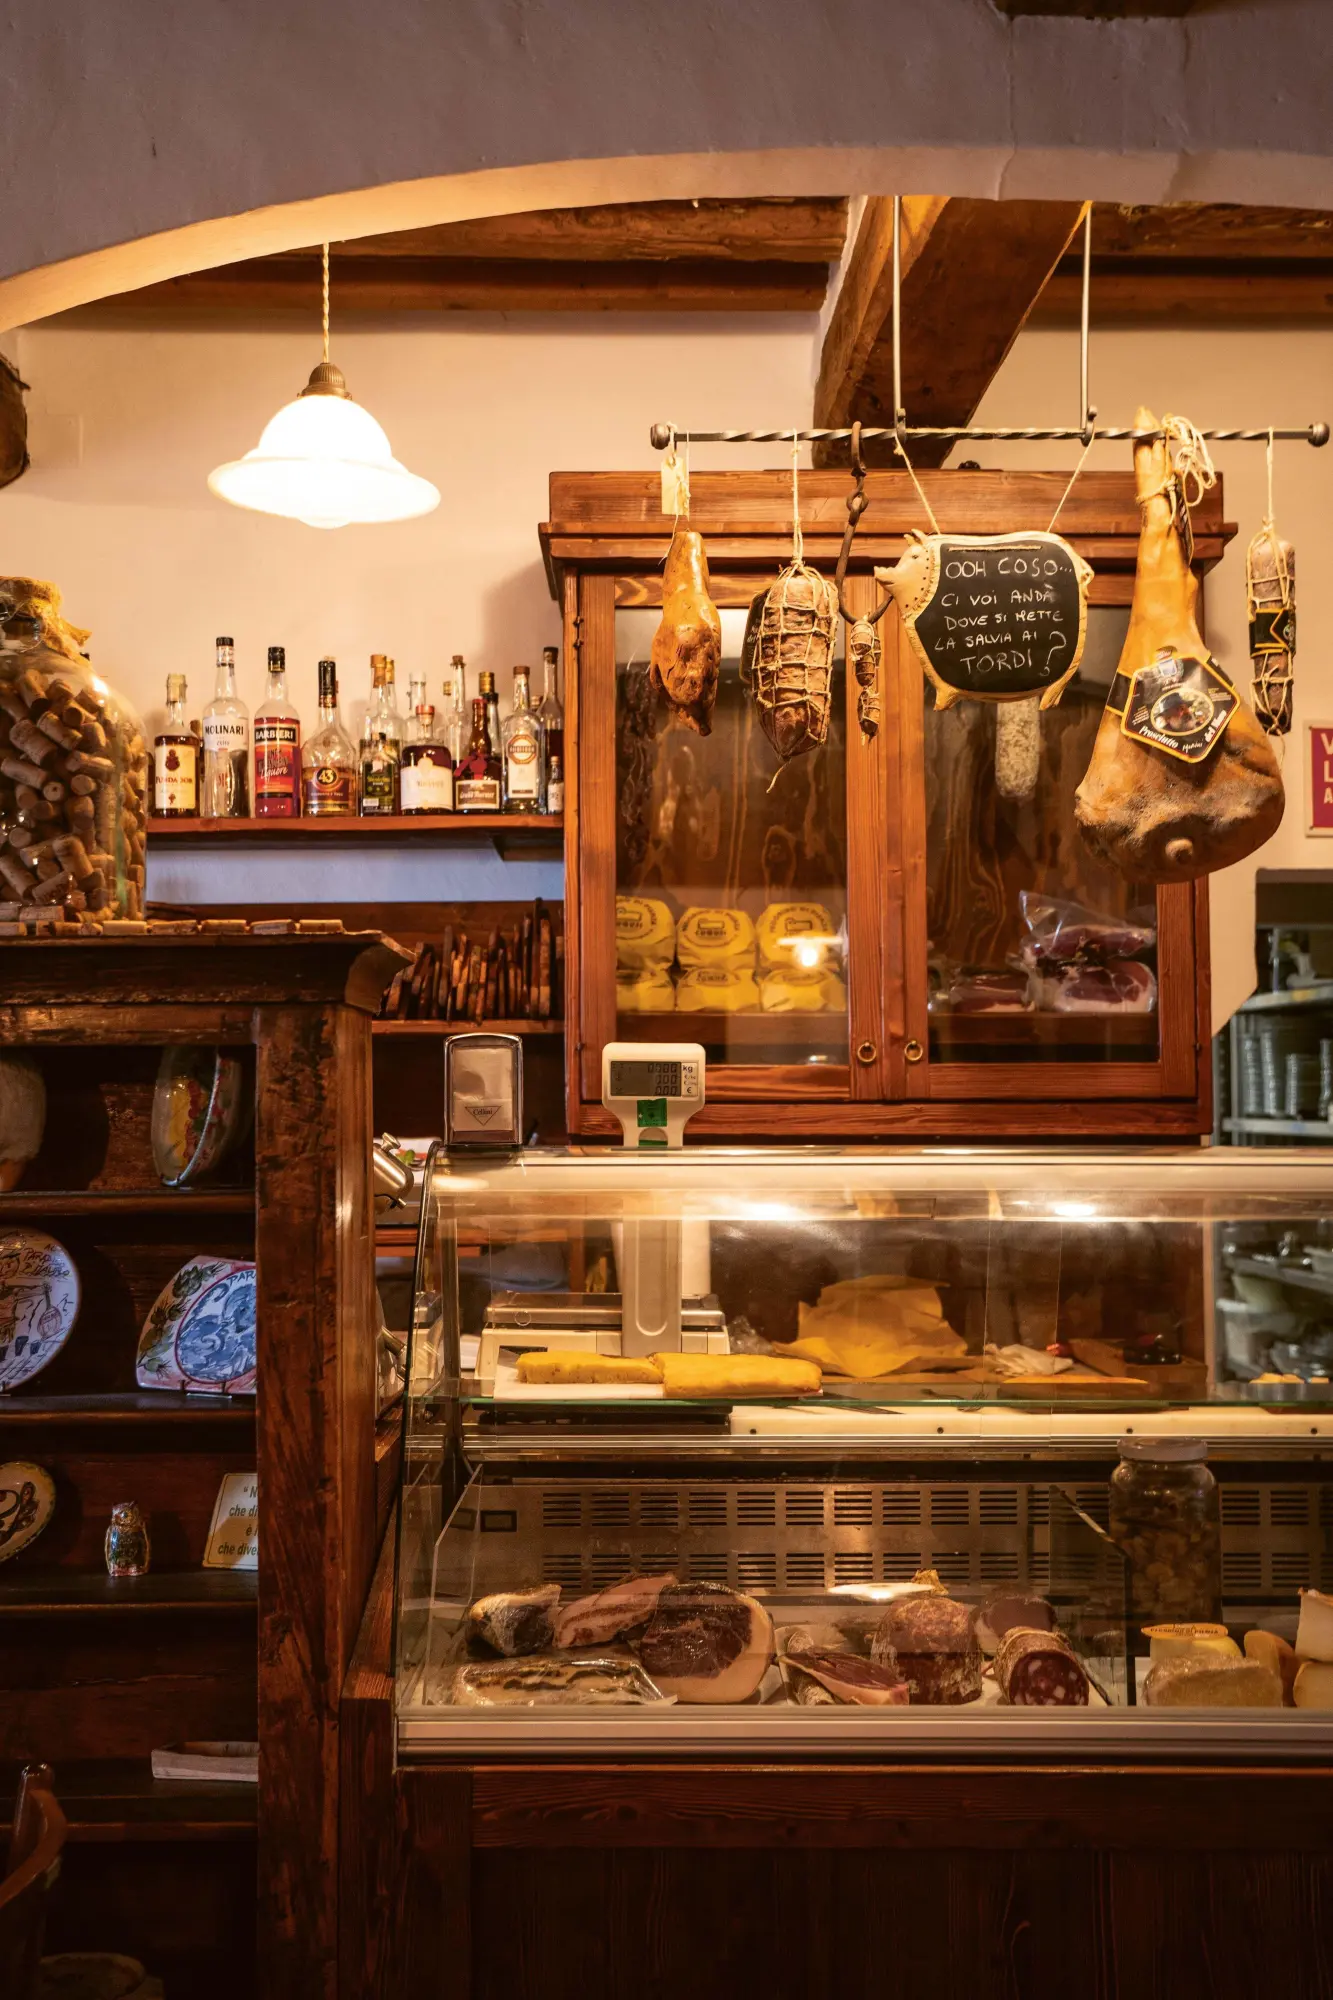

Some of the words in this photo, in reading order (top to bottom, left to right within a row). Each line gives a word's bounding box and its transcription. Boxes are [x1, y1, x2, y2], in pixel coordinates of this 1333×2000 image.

[945, 561, 986, 579] OOH
[944, 615, 988, 631] DOVE
[1014, 610, 1064, 622] METTE
[934, 637, 956, 651] LA
[965, 632, 1012, 648] SALVIA
[959, 649, 1033, 675] TORDI
[204, 725, 244, 736] MOLINARI
[318, 769, 334, 783] 43
[682, 1065, 693, 1073] kg
[472, 1108, 493, 1116] Cellini
[226, 1270, 256, 1287] PAR
[229, 1504, 247, 1517] che
[218, 1541, 235, 1555] che
[237, 1542, 258, 1557] dive
